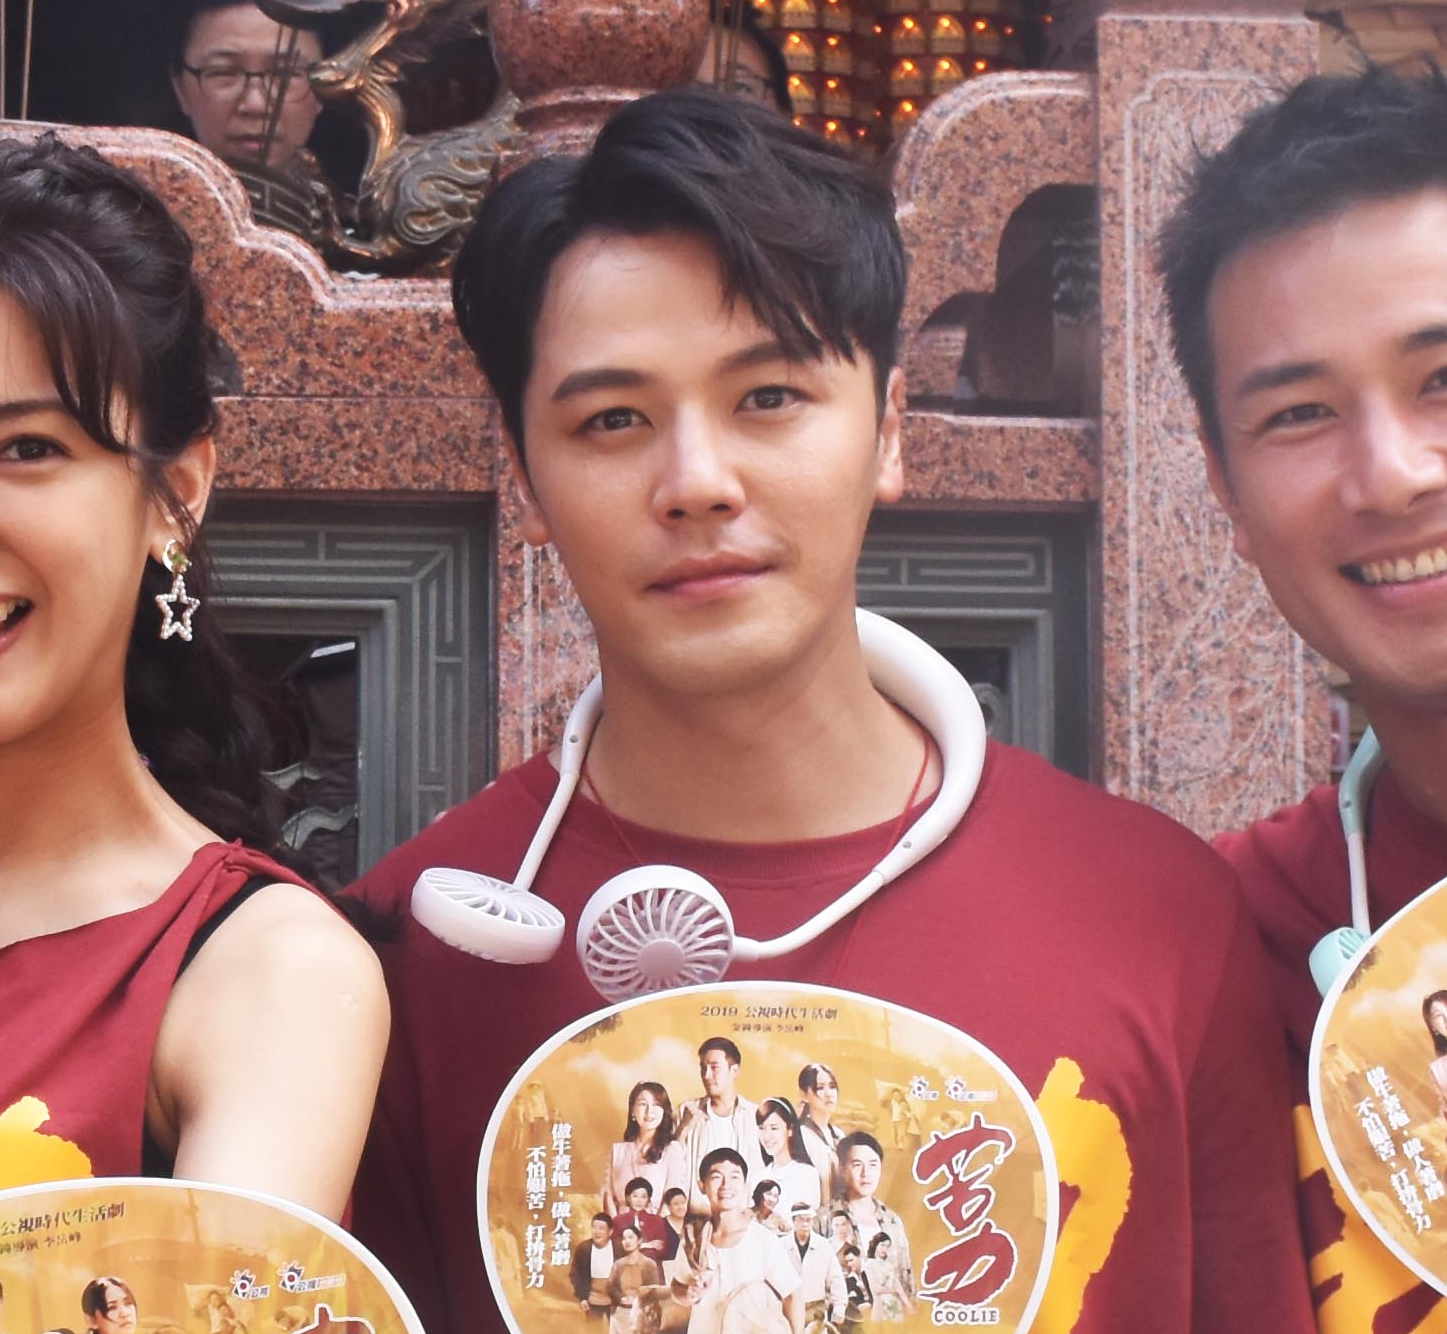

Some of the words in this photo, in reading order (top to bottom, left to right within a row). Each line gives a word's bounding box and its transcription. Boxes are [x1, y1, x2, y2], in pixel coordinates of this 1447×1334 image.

[700, 1006, 738, 1017] 2019
[1, 1202, 125, 1237] 公視時代生活劇
[934, 1310, 997, 1323] COOLIE
